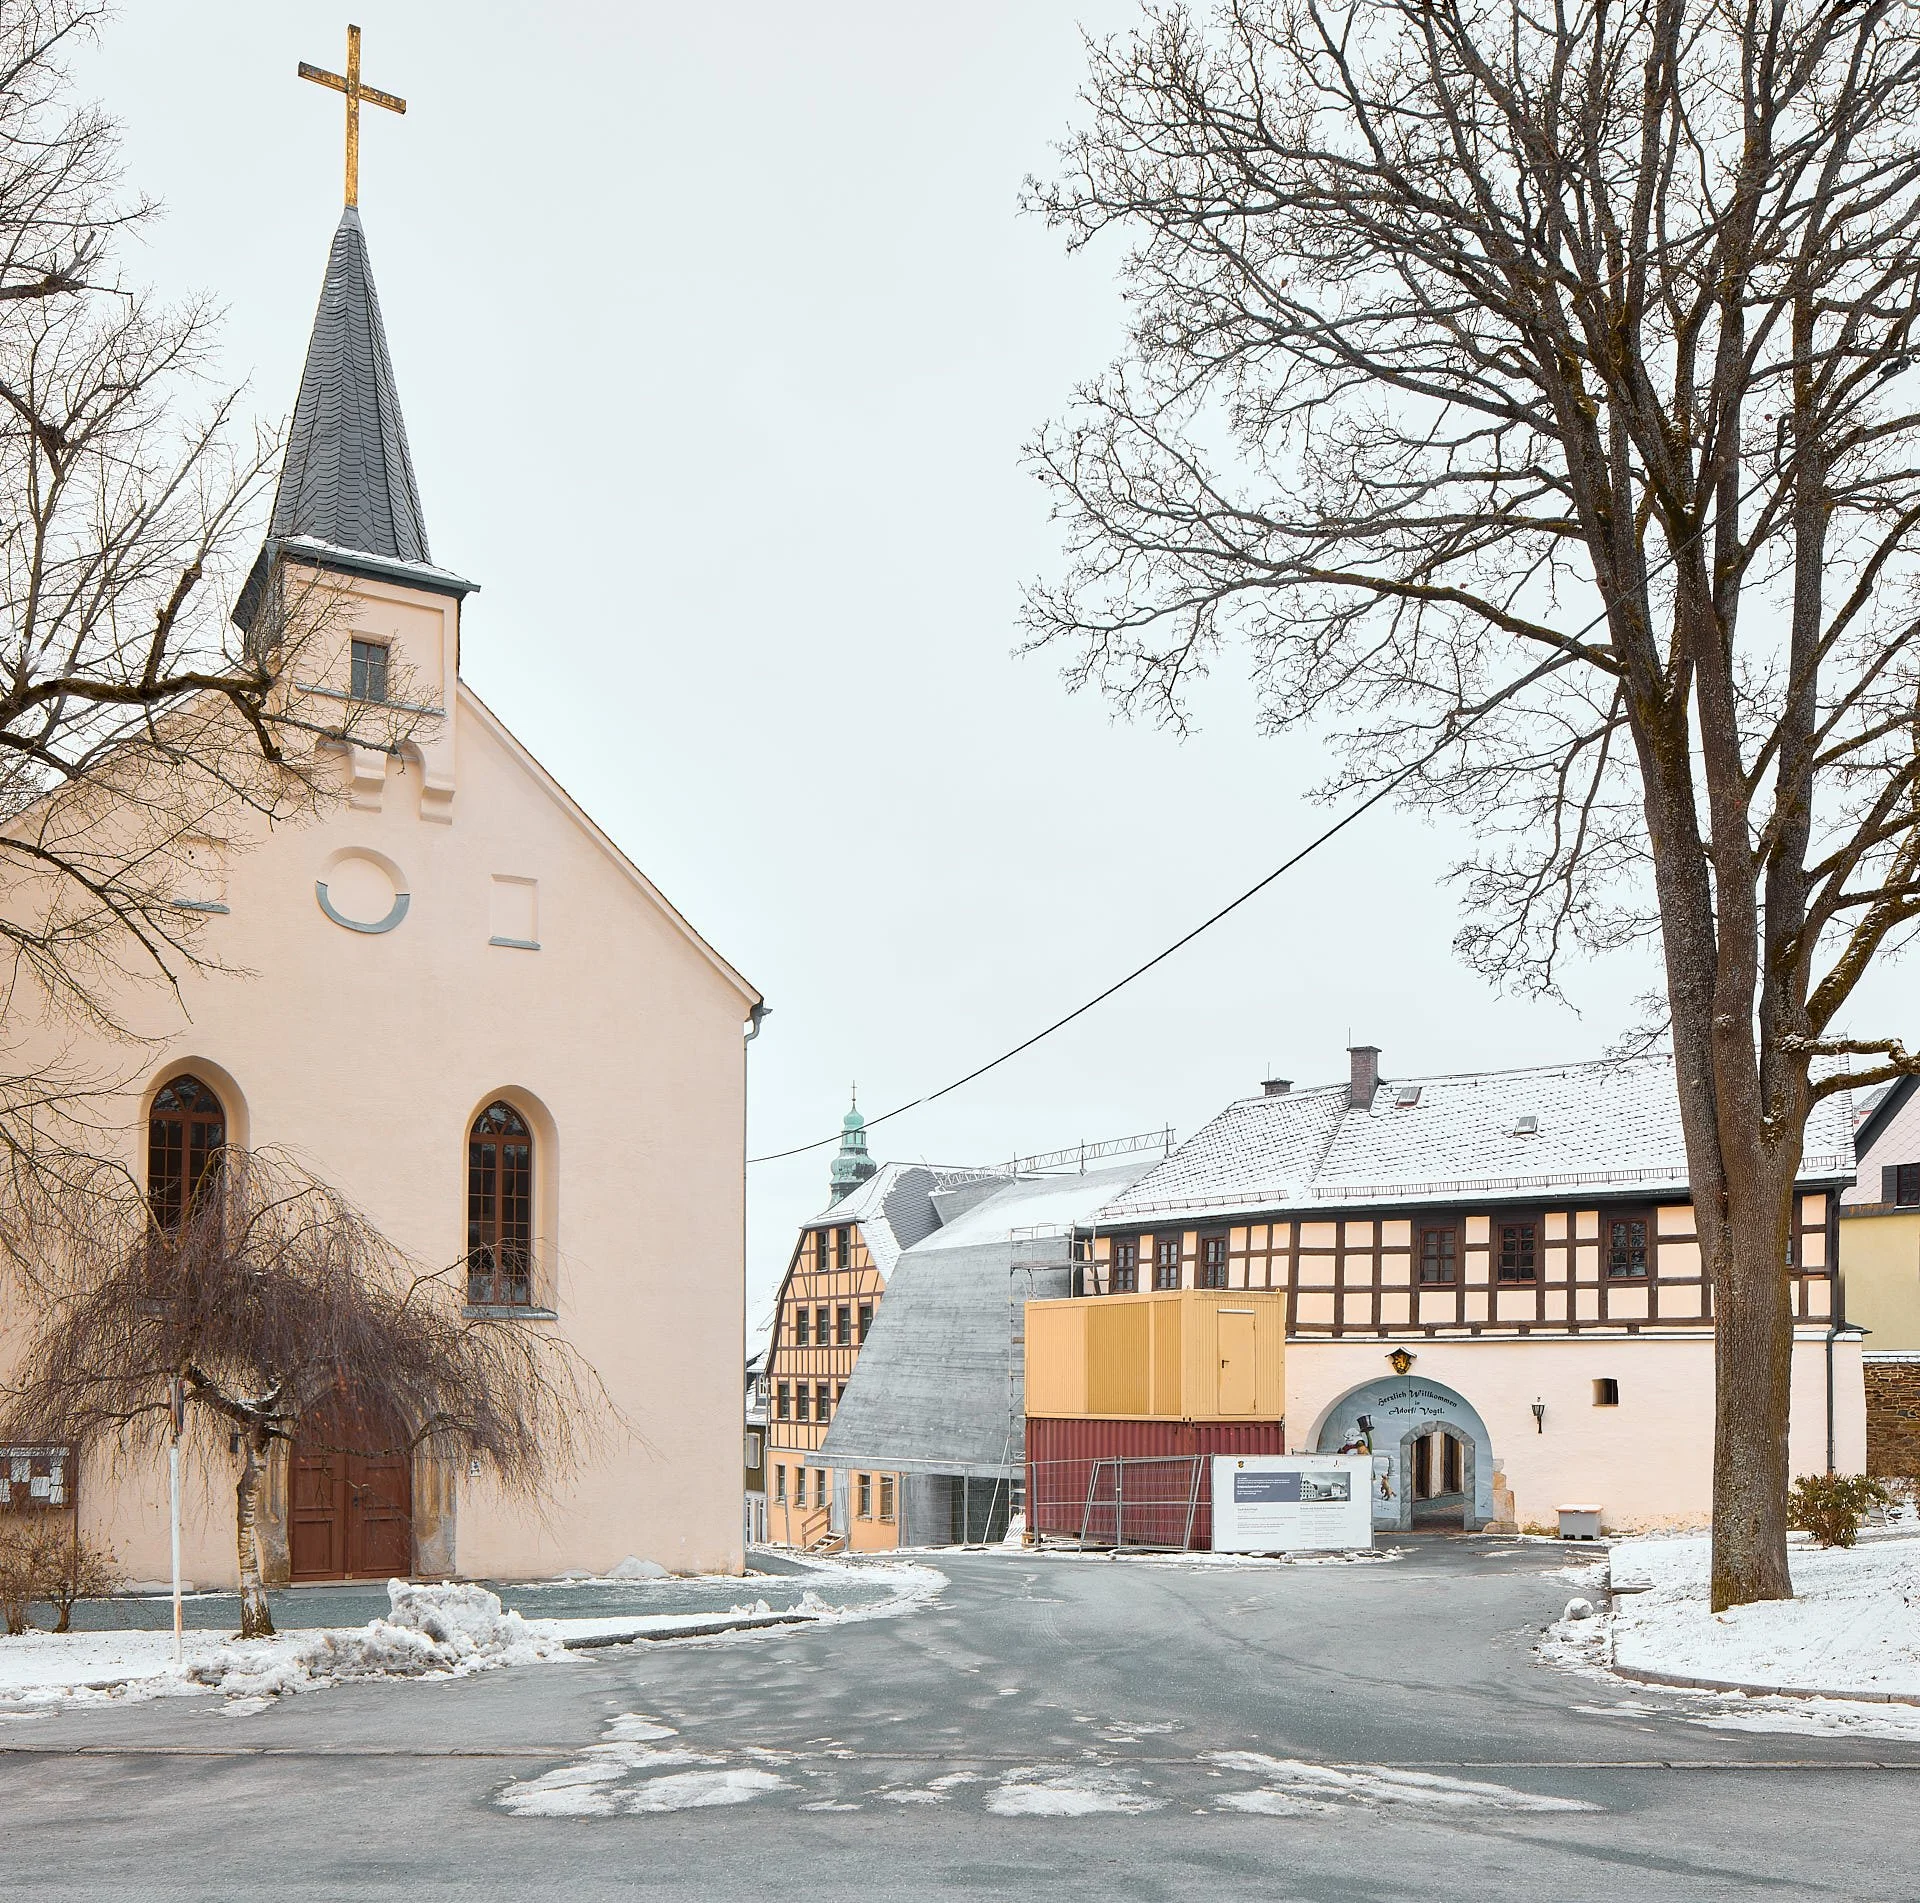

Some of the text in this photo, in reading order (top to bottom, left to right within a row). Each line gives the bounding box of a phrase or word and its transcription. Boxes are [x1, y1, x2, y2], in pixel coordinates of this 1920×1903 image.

[1377, 1389, 1458, 1408] Herzlich Willkommen
[1419, 1407, 1445, 1416] Vogtl.
